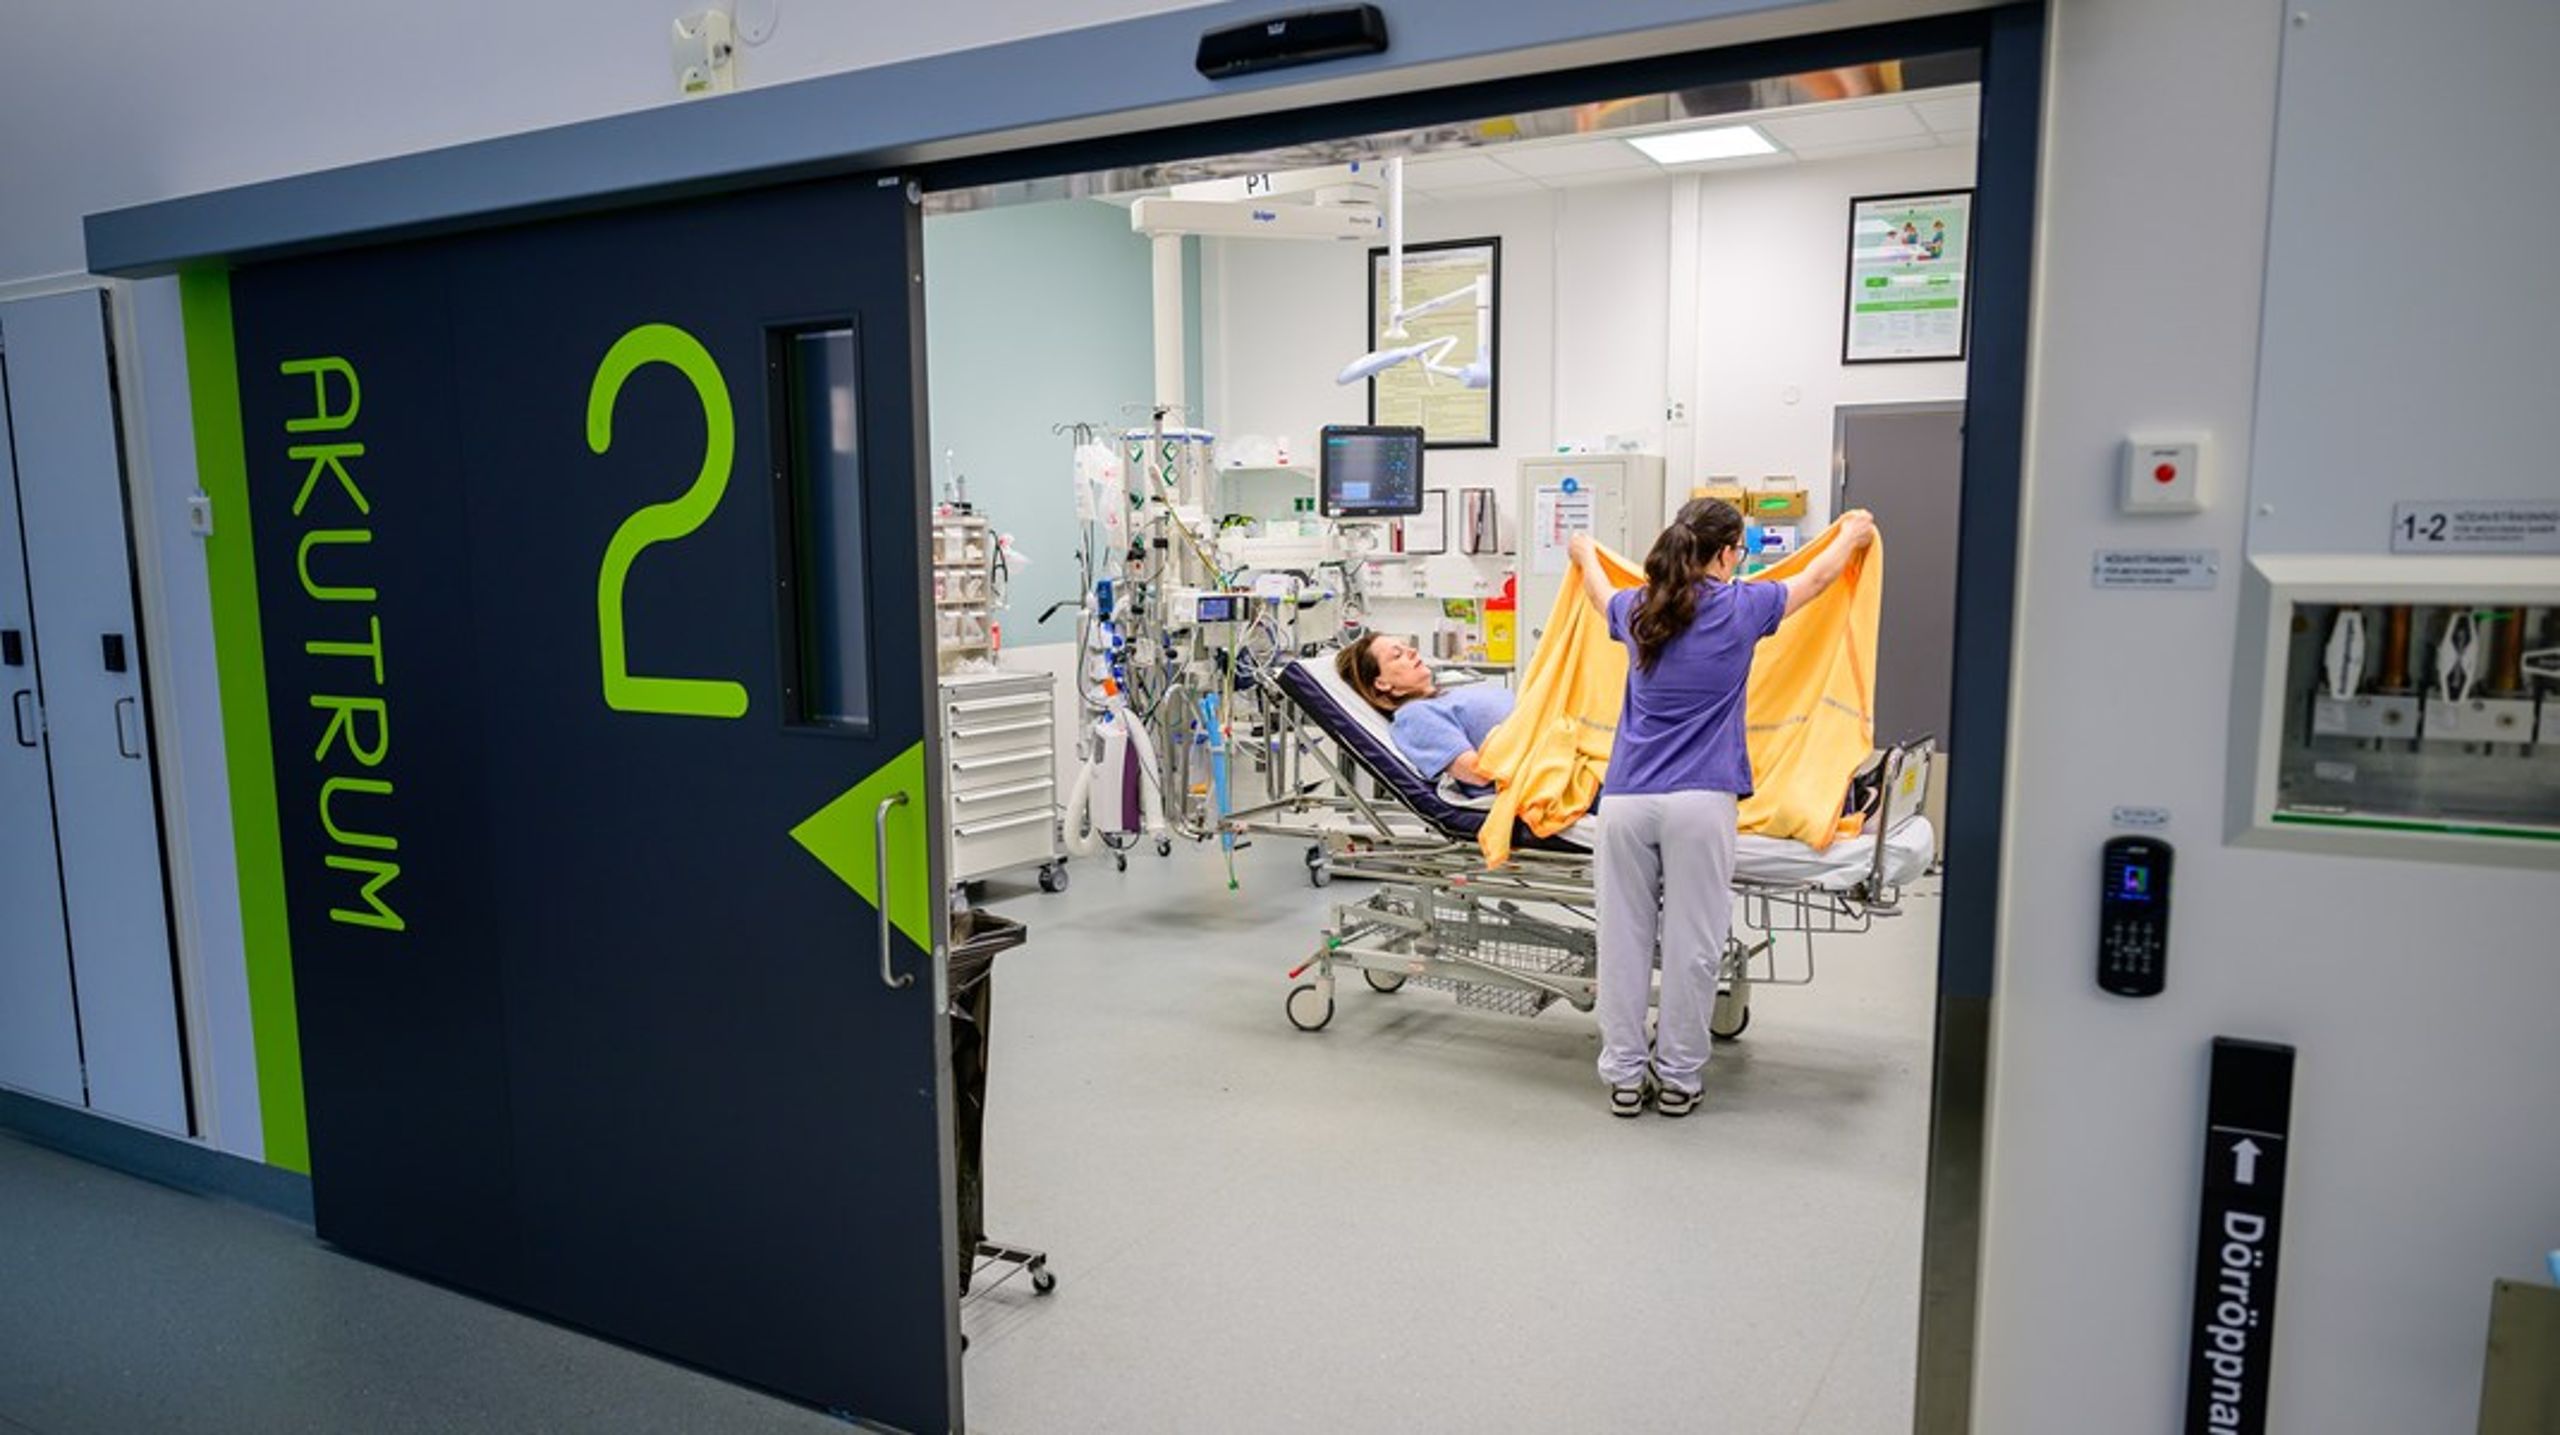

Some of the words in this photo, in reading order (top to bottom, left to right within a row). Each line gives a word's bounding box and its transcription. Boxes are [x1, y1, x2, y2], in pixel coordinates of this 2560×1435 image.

[1246, 174, 1270, 194] P1
[586, 323, 749, 718] 2
[2403, 513, 2447, 541] 1-2
[280, 356, 405, 931] AKUTRUM
